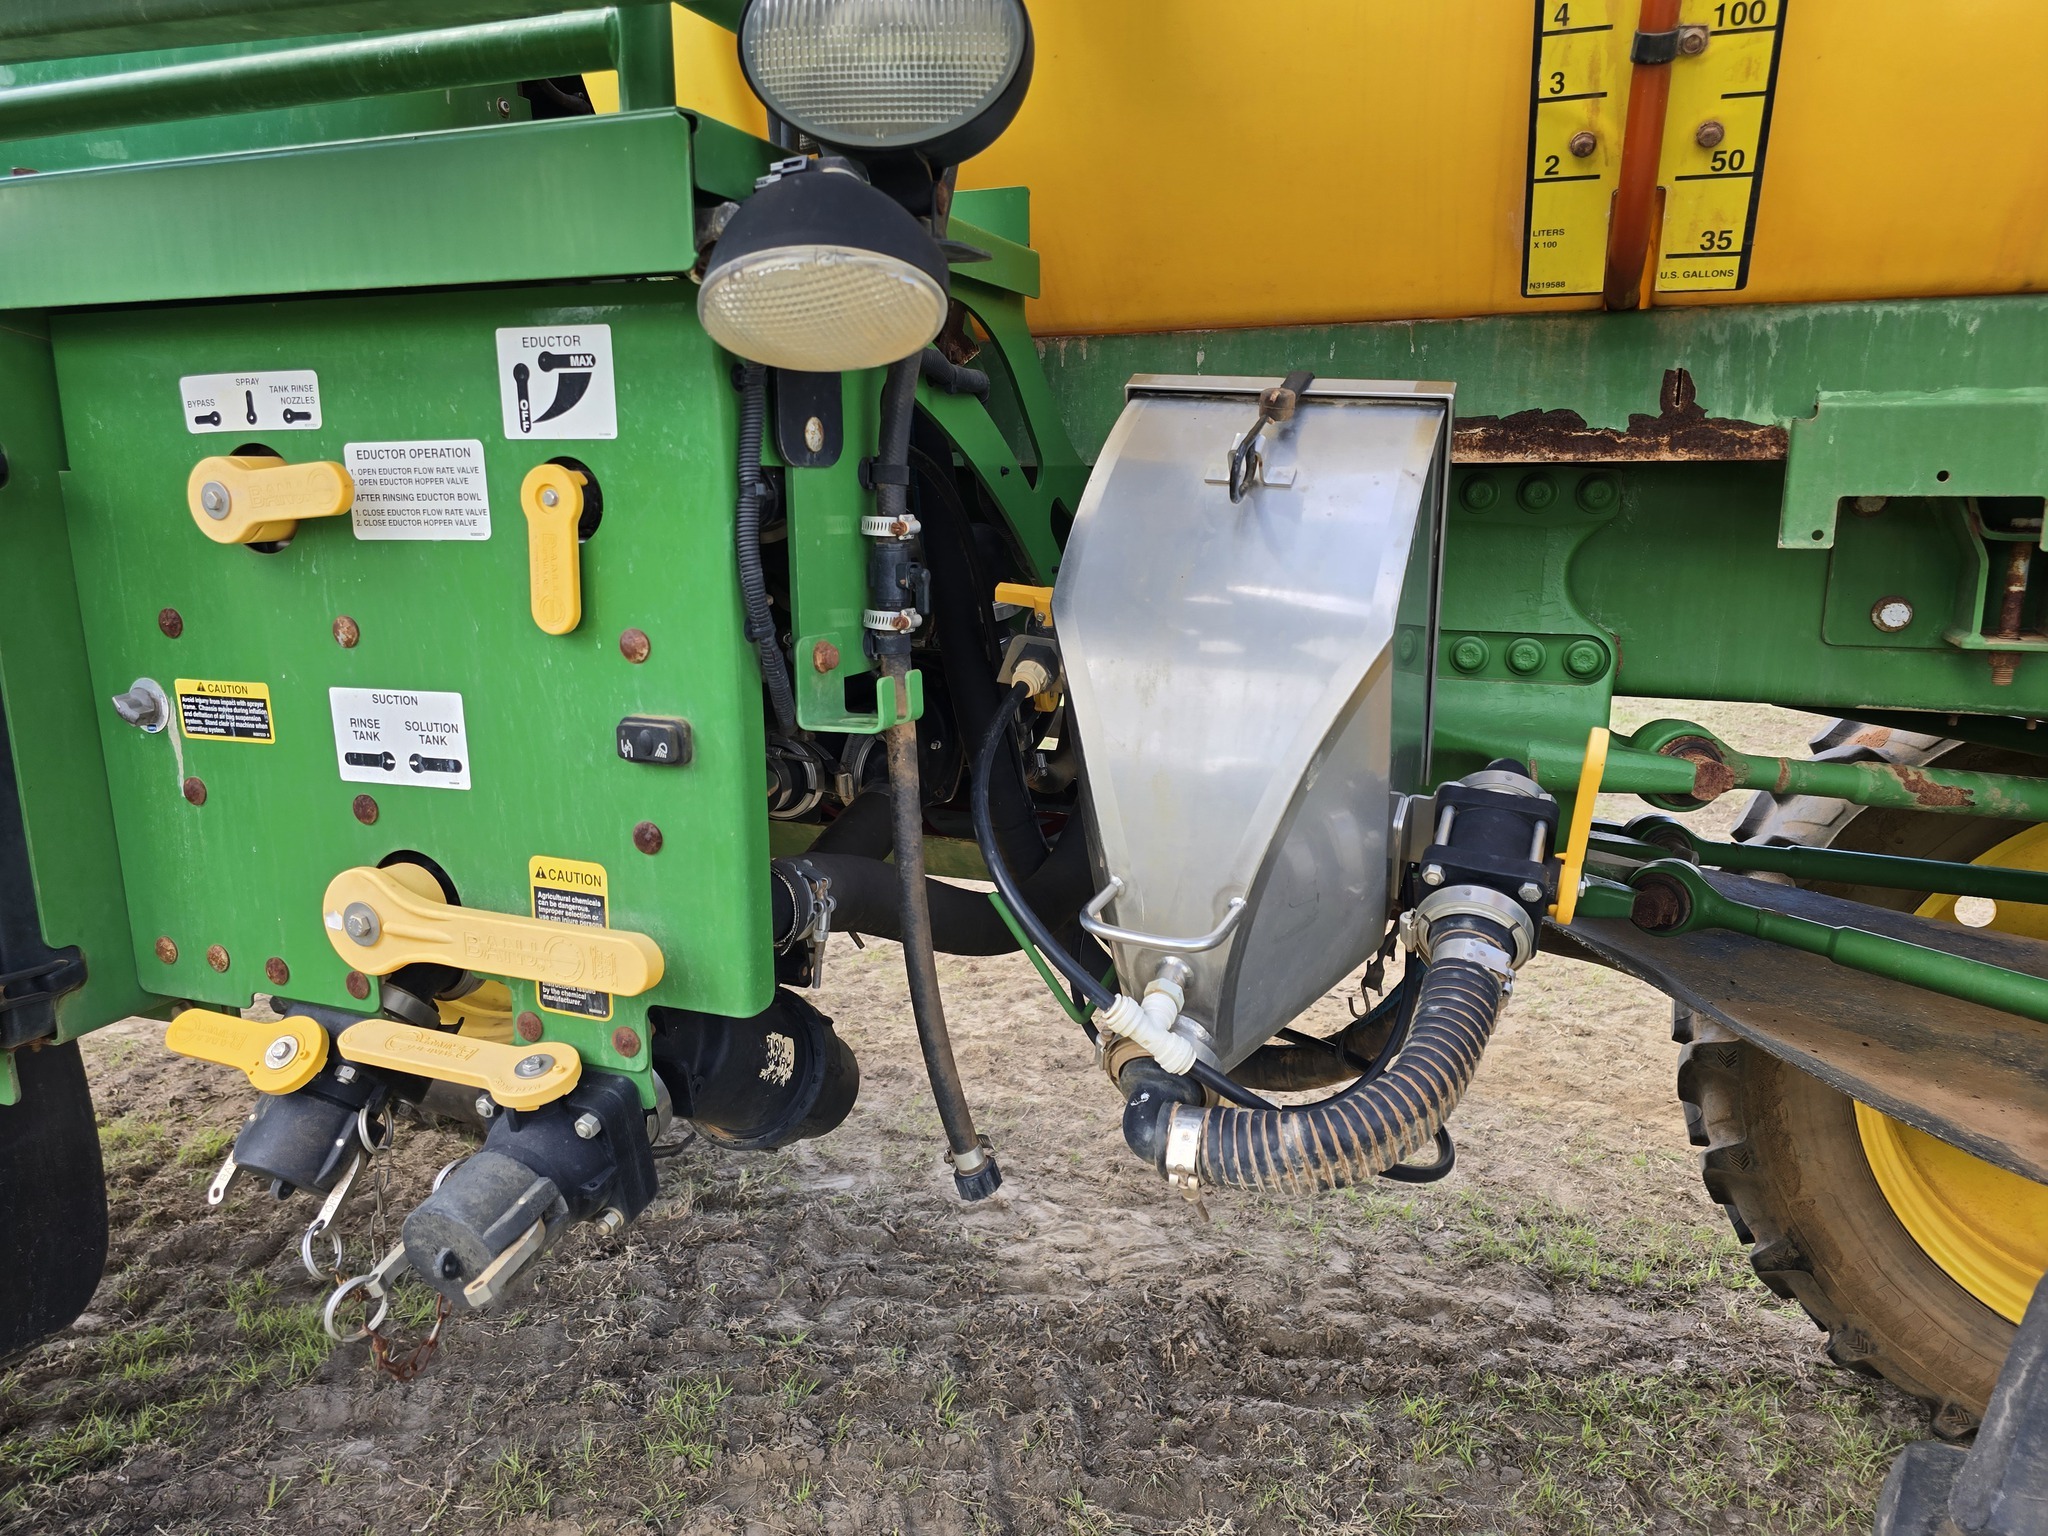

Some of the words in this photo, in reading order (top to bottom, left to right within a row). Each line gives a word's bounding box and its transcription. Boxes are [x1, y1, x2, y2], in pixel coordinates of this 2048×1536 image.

[1554, 3, 1570, 26] 4
[1714, 0, 1766, 27] 100
[1550, 72, 1565, 94] 3
[1544, 155, 1560, 176] 2
[1710, 149, 1745, 172] 50
[1532, 228, 1565, 237] LITERS
[1542, 241, 1558, 249] 100
[1700, 230, 1733, 251] 35
[1660, 271, 1680, 280] U.S.
[1682, 269, 1734, 279] GALLONS
[1529, 281, 1566, 289] N319588
[522, 335, 581, 348] EDUCTOR
[570, 354, 594, 367] MAX
[235, 378, 260, 386] SPRAY
[269, 385, 290, 393] TANK
[291, 384, 314, 393] RINSE
[187, 398, 215, 408] BYPASS
[280, 396, 315, 405] NOZZLES
[519, 399, 530, 432] OFF
[356, 449, 406, 460] EDUCTOR
[409, 447, 471, 459] OPERATION
[357, 468, 377, 476] OPEN
[378, 467, 412, 475] EDUCTOR
[413, 467, 434, 475] FLOW
[436, 466, 455, 474] RATE
[456, 466, 479, 474] VALVE
[358, 478, 378, 486] OPEN
[379, 478, 413, 486] EDUCTOR
[415, 477, 445, 485] HOPPER
[446, 477, 469, 485] VALVE
[356, 494, 380, 502] AFTER
[382, 493, 415, 502] RINSING
[416, 493, 456, 501] EDUCTOR
[457, 492, 482, 501] BOWL
[362, 509, 385, 517] CLOSE
[445, 508, 464, 516] RATE
[465, 508, 488, 516] VALVE
[363, 519, 386, 527] CLOSE
[207, 683, 248, 695] CAUTION
[372, 693, 418, 706] SUCTION
[350, 717, 380, 729] RINSE
[405, 720, 459, 734] SOLUTION
[353, 730, 380, 742] TANK
[418, 734, 448, 746] TANK
[548, 868, 602, 887] CAUTION
[538, 891, 571, 903] Agricultural
[571, 896, 601, 907] chemicals
[538, 905, 564, 916] Improper
[565, 910, 591, 920] selection
[558, 902, 590, 913] dangerous.
[542, 986, 551, 994] by
[551, 987, 560, 995] the
[560, 990, 587, 1000] chemical
[542, 994, 582, 1006] manufacturer.
